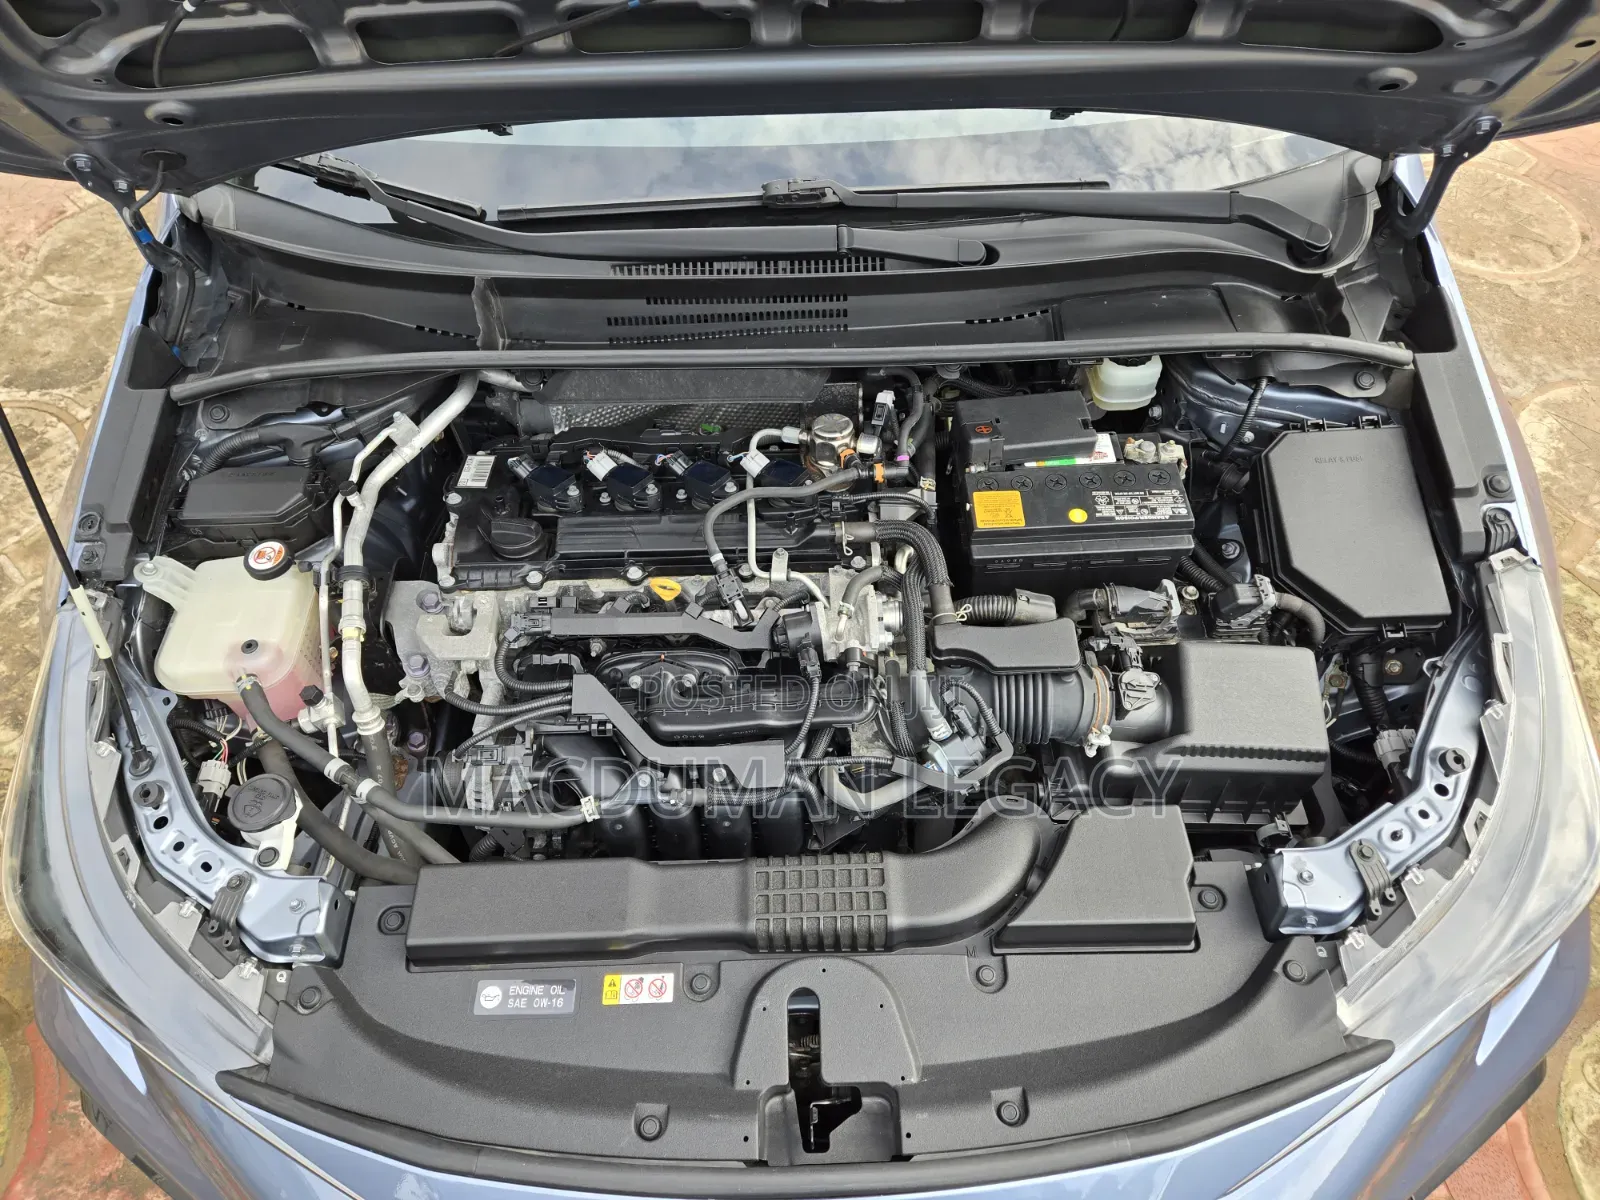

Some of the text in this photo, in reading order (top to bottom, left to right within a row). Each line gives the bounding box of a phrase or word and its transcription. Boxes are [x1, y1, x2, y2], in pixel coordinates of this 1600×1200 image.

[508, 984, 566, 996] ENGINE OIL
[507, 997, 564, 1009] SAE 0W-16
